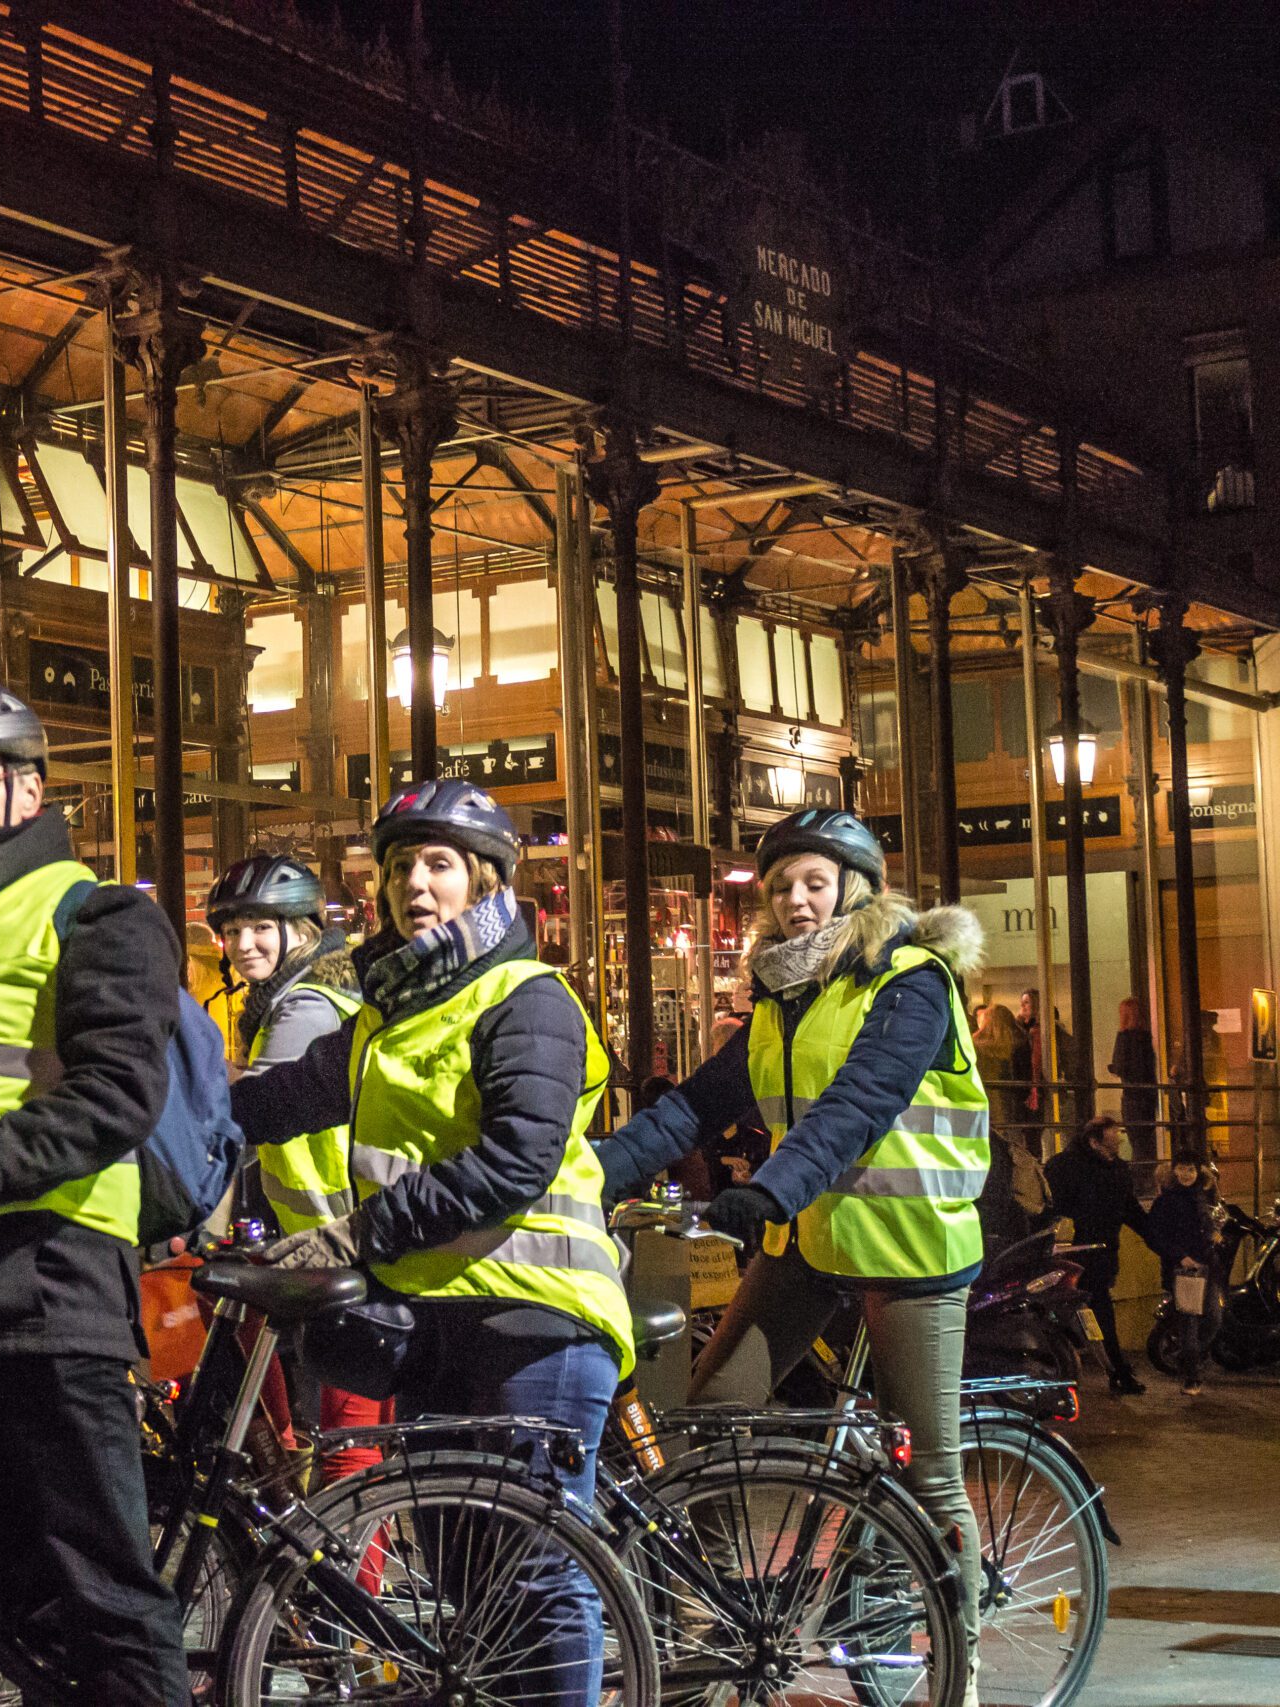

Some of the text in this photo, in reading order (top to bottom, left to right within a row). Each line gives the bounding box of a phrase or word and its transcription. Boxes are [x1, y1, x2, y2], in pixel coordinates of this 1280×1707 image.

[756, 244, 831, 297] MERCADO
[786, 287, 807, 311] DE
[754, 300, 837, 356] SAN MIGUEL
[627, 1402, 645, 1435] Bike
